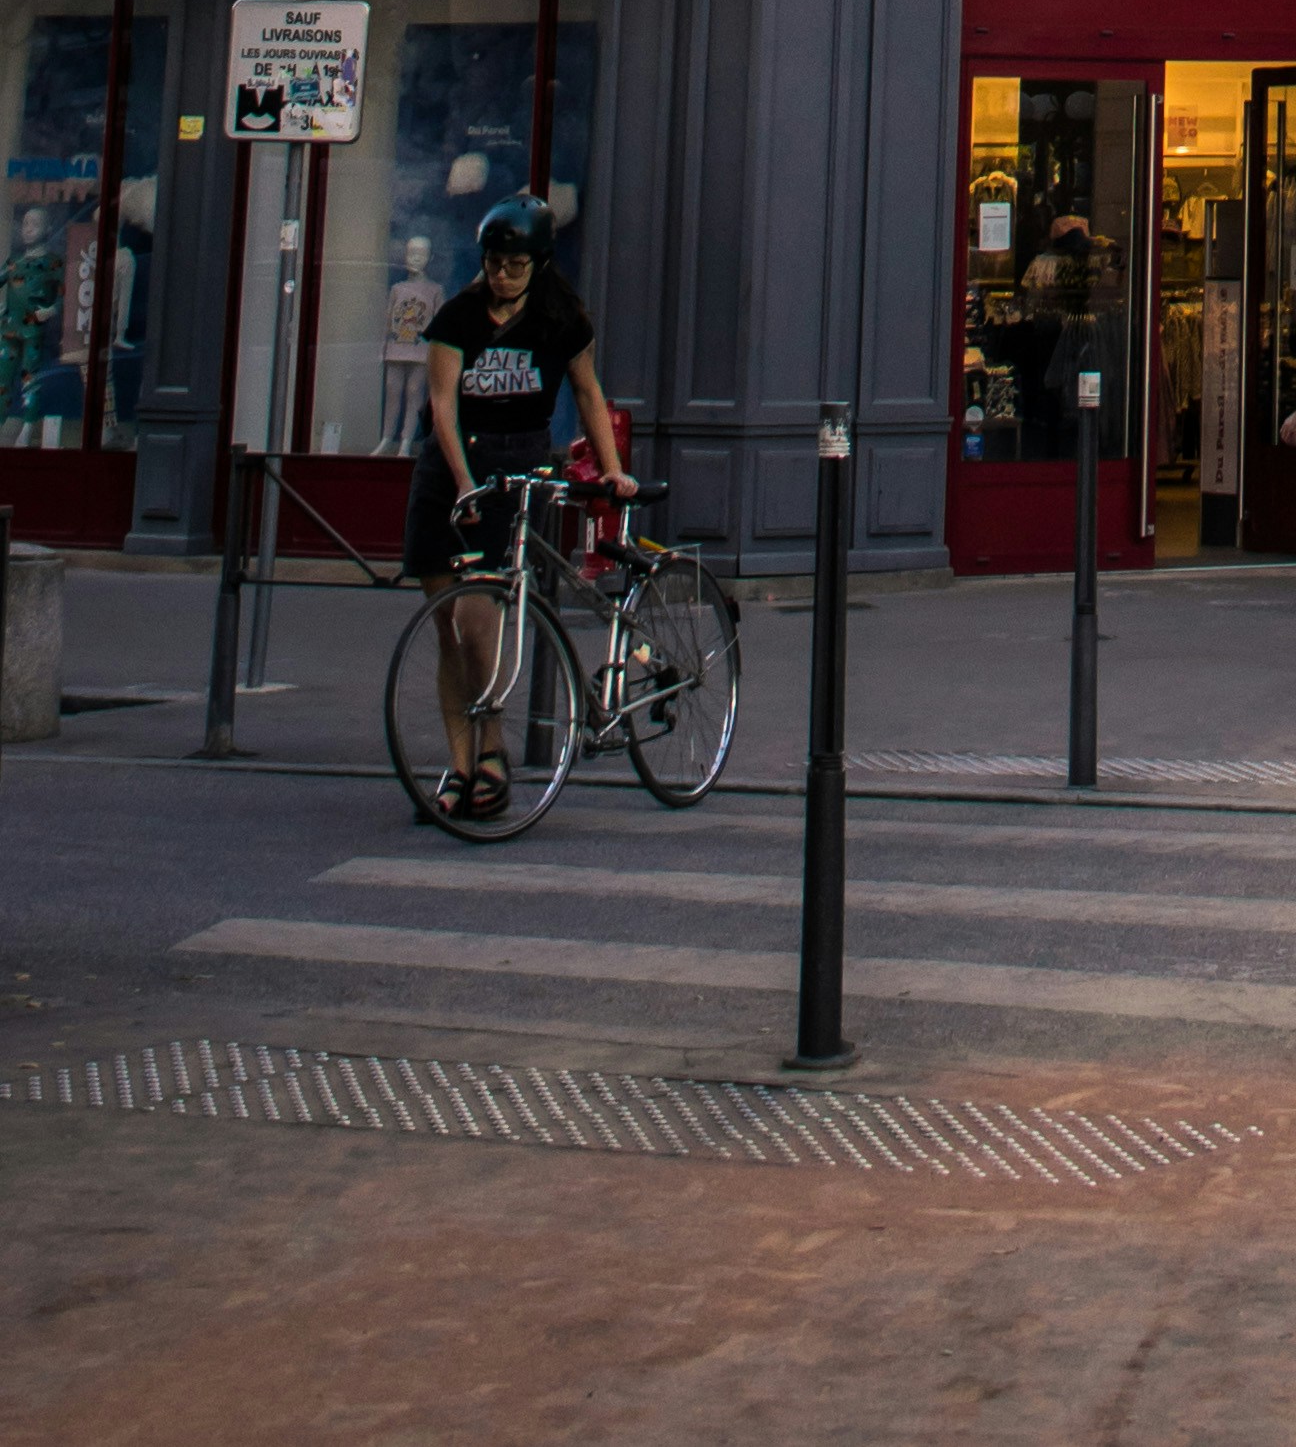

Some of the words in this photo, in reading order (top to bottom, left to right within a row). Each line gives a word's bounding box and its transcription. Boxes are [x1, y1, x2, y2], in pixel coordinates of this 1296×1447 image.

[286, 11, 321, 25] SAUF
[262, 28, 342, 43] LIVRAISONS
[241, 48, 260, 59] LES
[263, 48, 297, 60] JOURS
[254, 62, 273, 77] DE
